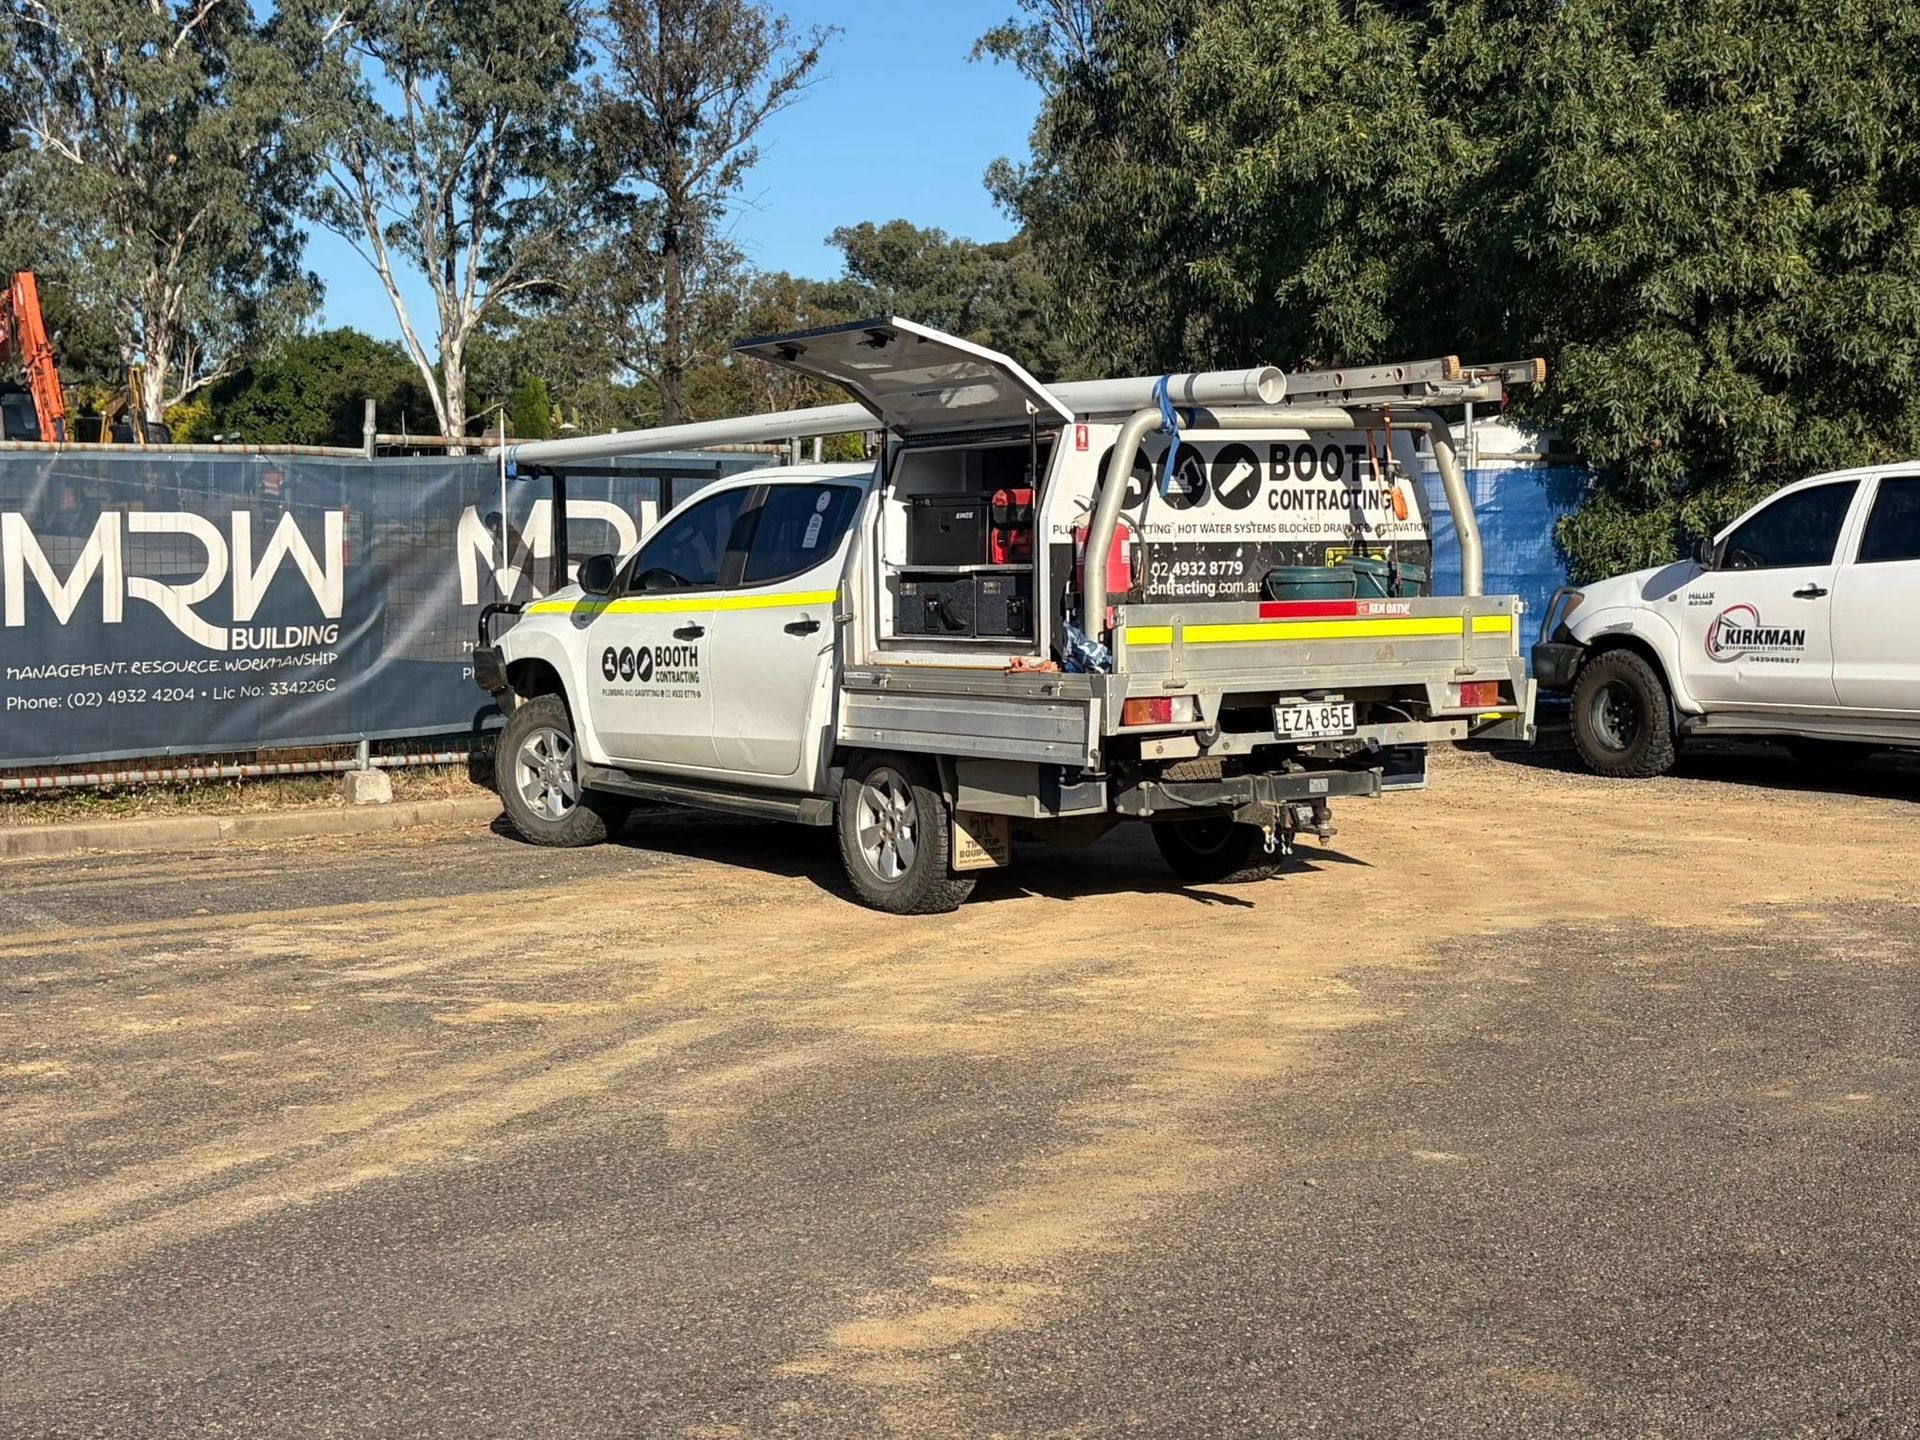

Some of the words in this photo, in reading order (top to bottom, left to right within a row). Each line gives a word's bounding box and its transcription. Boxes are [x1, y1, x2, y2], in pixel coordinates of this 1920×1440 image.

[1269, 443, 1389, 482] BOOTH
[1268, 489, 1391, 511] CONTRACTING
[1177, 523, 1198, 534] HOT
[1200, 523, 1232, 534] WATER
[1234, 523, 1277, 534] SYSTEMS
[1279, 523, 1321, 534] BLOCKED
[1151, 562, 1169, 576] 02
[1172, 561, 1206, 576] 4932
[1209, 561, 1244, 576] 8779
[1, 511, 345, 651] MRW
[232, 624, 339, 651] BUILDING
[1725, 629, 1805, 646] KIRKMAN
[130, 659, 222, 675] RESOURCE.
[225, 650, 339, 672] WORKMANSHIP
[654, 646, 698, 667] BOOTH
[655, 671, 700, 683] CONTRACTING
[6, 695, 62, 711] Phone:
[67, 691, 103, 709] (02)
[107, 689, 147, 704] 4932
[152, 688, 195, 702] 4204
[213, 686, 236, 700] Lic
[240, 685, 265, 698] No:
[269, 678, 337, 696] 334226C
